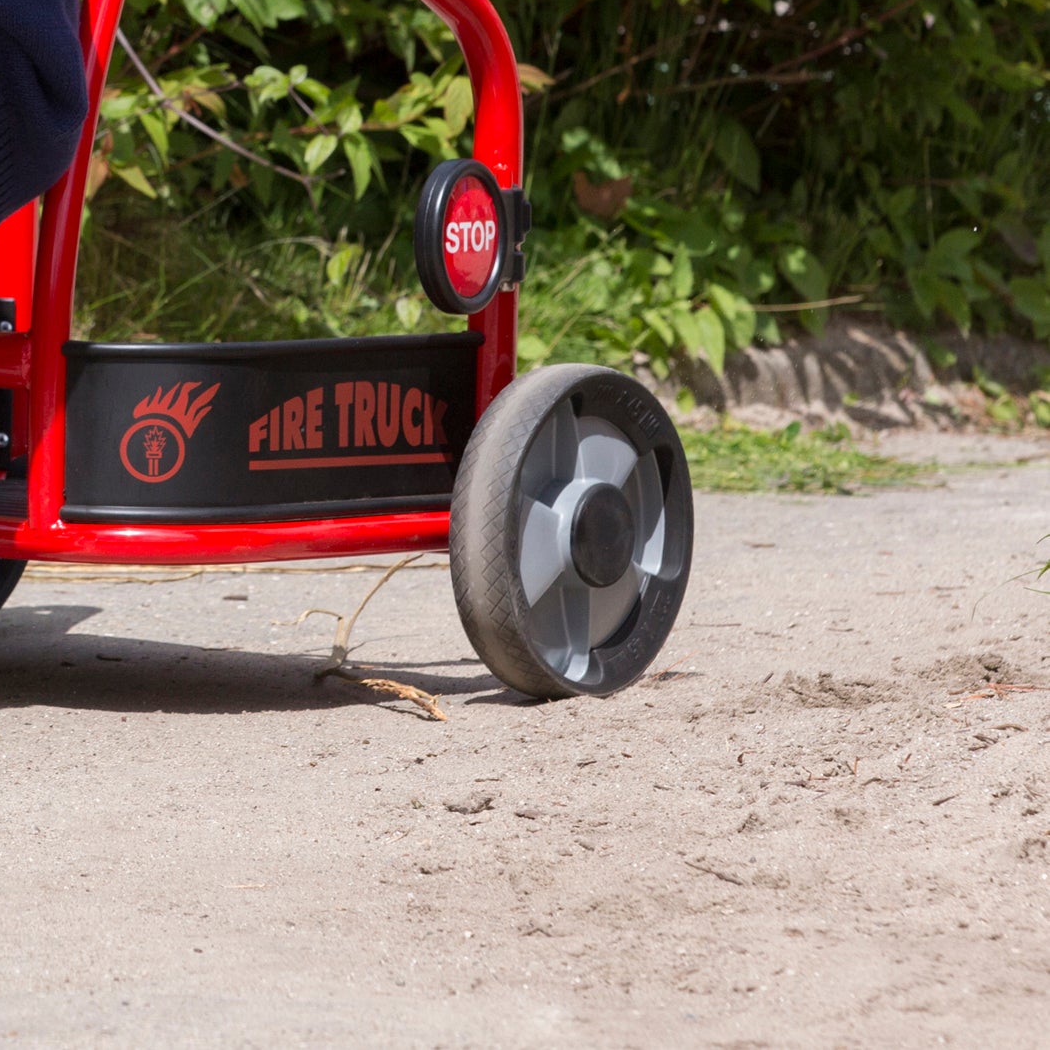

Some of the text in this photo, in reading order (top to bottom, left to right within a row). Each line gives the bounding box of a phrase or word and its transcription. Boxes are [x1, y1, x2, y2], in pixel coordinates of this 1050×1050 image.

[445, 220, 496, 254] STOP
[249, 381, 449, 453] FIRE TRUCK
